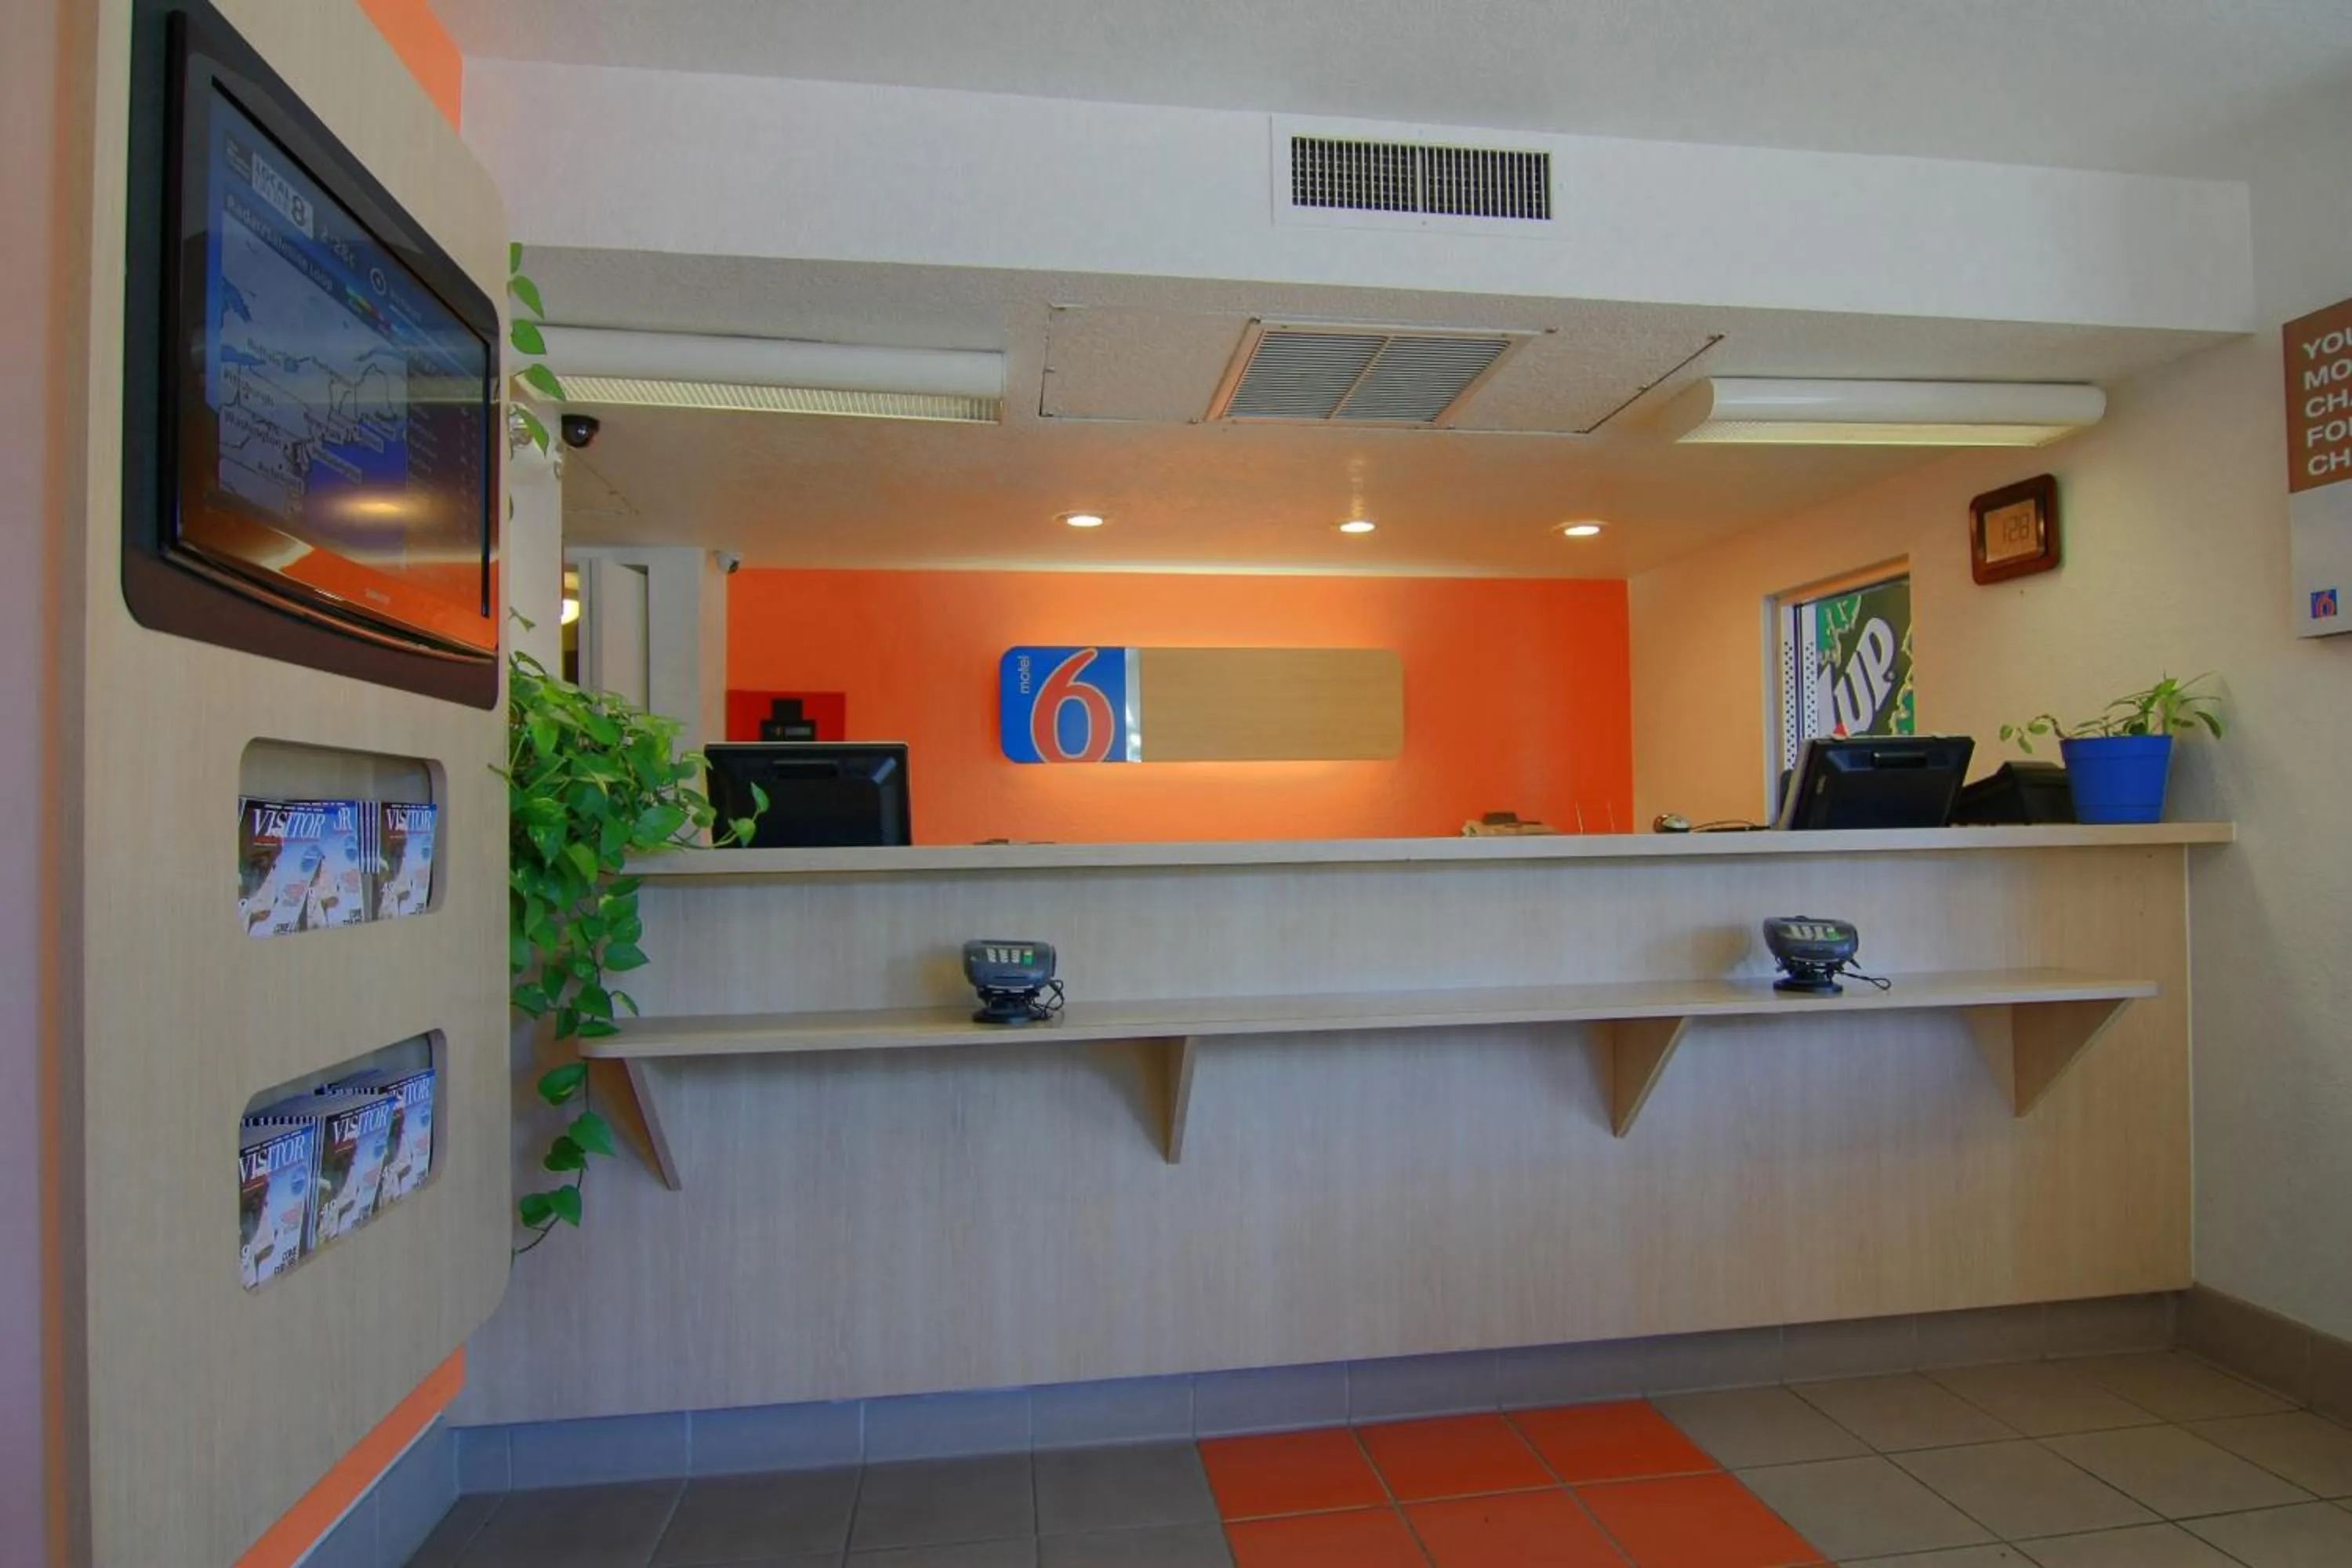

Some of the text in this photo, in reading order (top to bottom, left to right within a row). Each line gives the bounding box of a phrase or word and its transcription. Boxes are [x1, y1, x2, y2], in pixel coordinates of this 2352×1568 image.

[291, 195, 307, 227] 8
[2305, 389, 2352, 419] CH
[1018, 648, 1115, 764] motel 6
[253, 808, 326, 838] VISITOR
[386, 808, 432, 832] VISITOR
[332, 1102, 390, 1143] VISITOR
[238, 1134, 306, 1184] VISITOR
